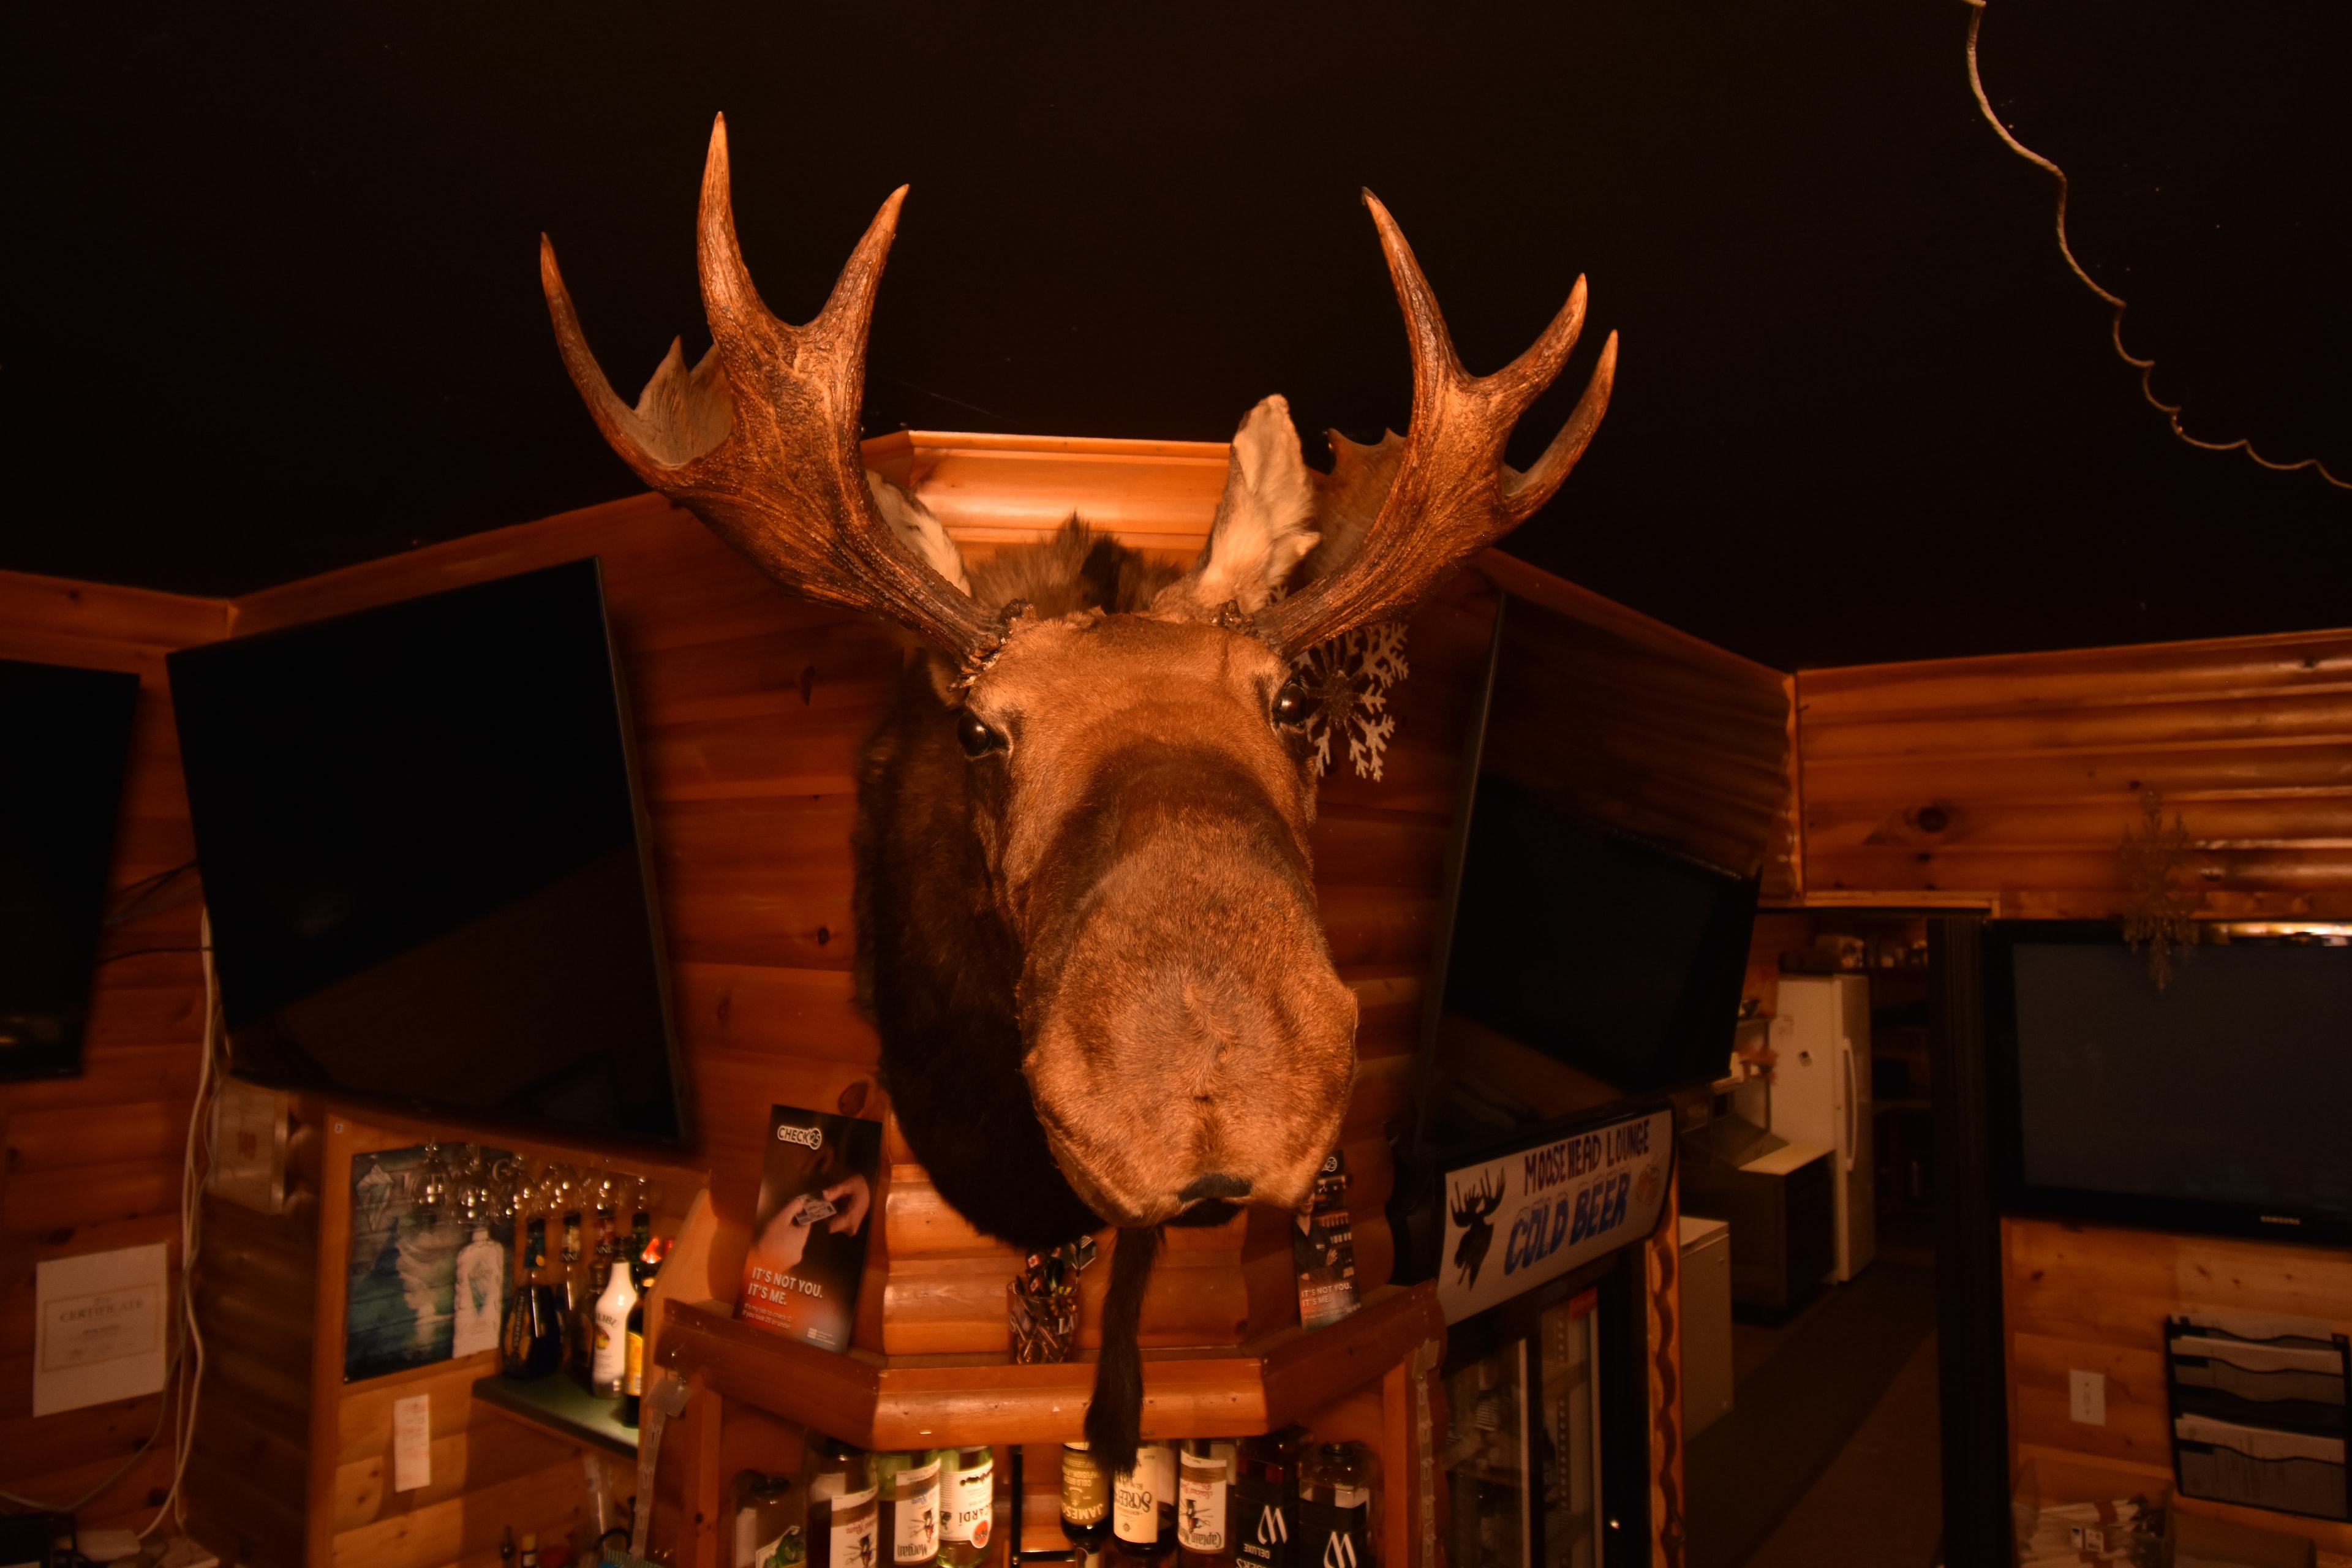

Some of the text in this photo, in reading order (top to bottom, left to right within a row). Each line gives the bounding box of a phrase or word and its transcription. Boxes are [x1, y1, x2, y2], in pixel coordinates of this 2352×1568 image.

[1607, 1120, 1650, 1168] LOUNGE
[1504, 1170, 1631, 1276] COLD BEER
[752, 1266, 823, 1298] IT'S NOT YOU.
[1302, 1282, 1352, 1298] IT'S NOT YOU.
[747, 1283, 787, 1305] IT'S ME.
[1303, 1298, 1317, 1307] IT'S
[1061, 1502, 1104, 1520] JAMESO
[1191, 1532, 1222, 1548] Captain
[897, 1544, 927, 1557] Morgan
[1243, 1543, 1271, 1560] DELUXE
